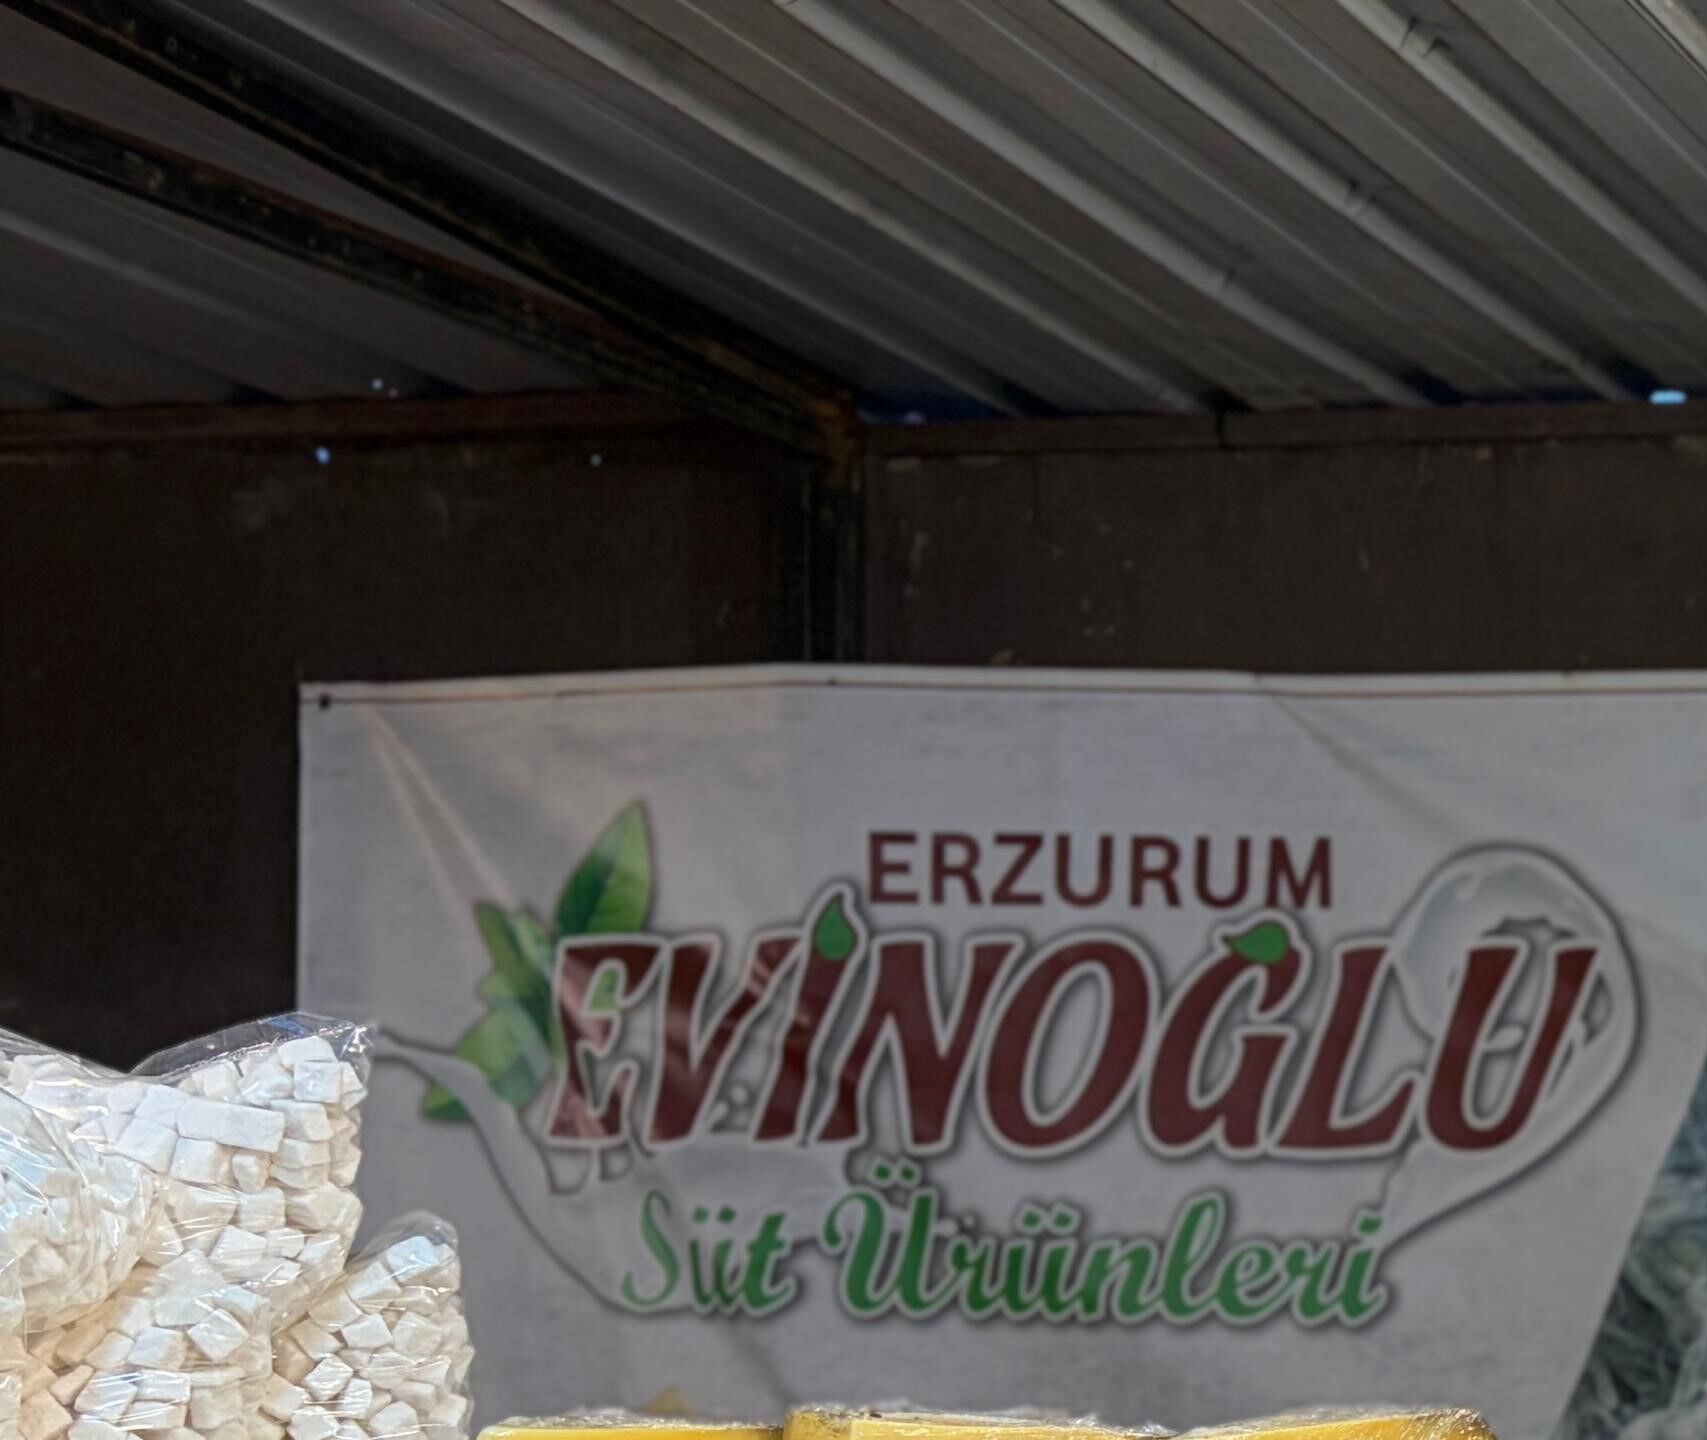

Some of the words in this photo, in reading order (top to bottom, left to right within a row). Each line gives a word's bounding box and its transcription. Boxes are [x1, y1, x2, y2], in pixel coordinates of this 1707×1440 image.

[867, 831, 1334, 910] ERZURUM
[620, 1188, 793, 1312] Süt
[823, 1163, 1387, 1321] Ürünleri
